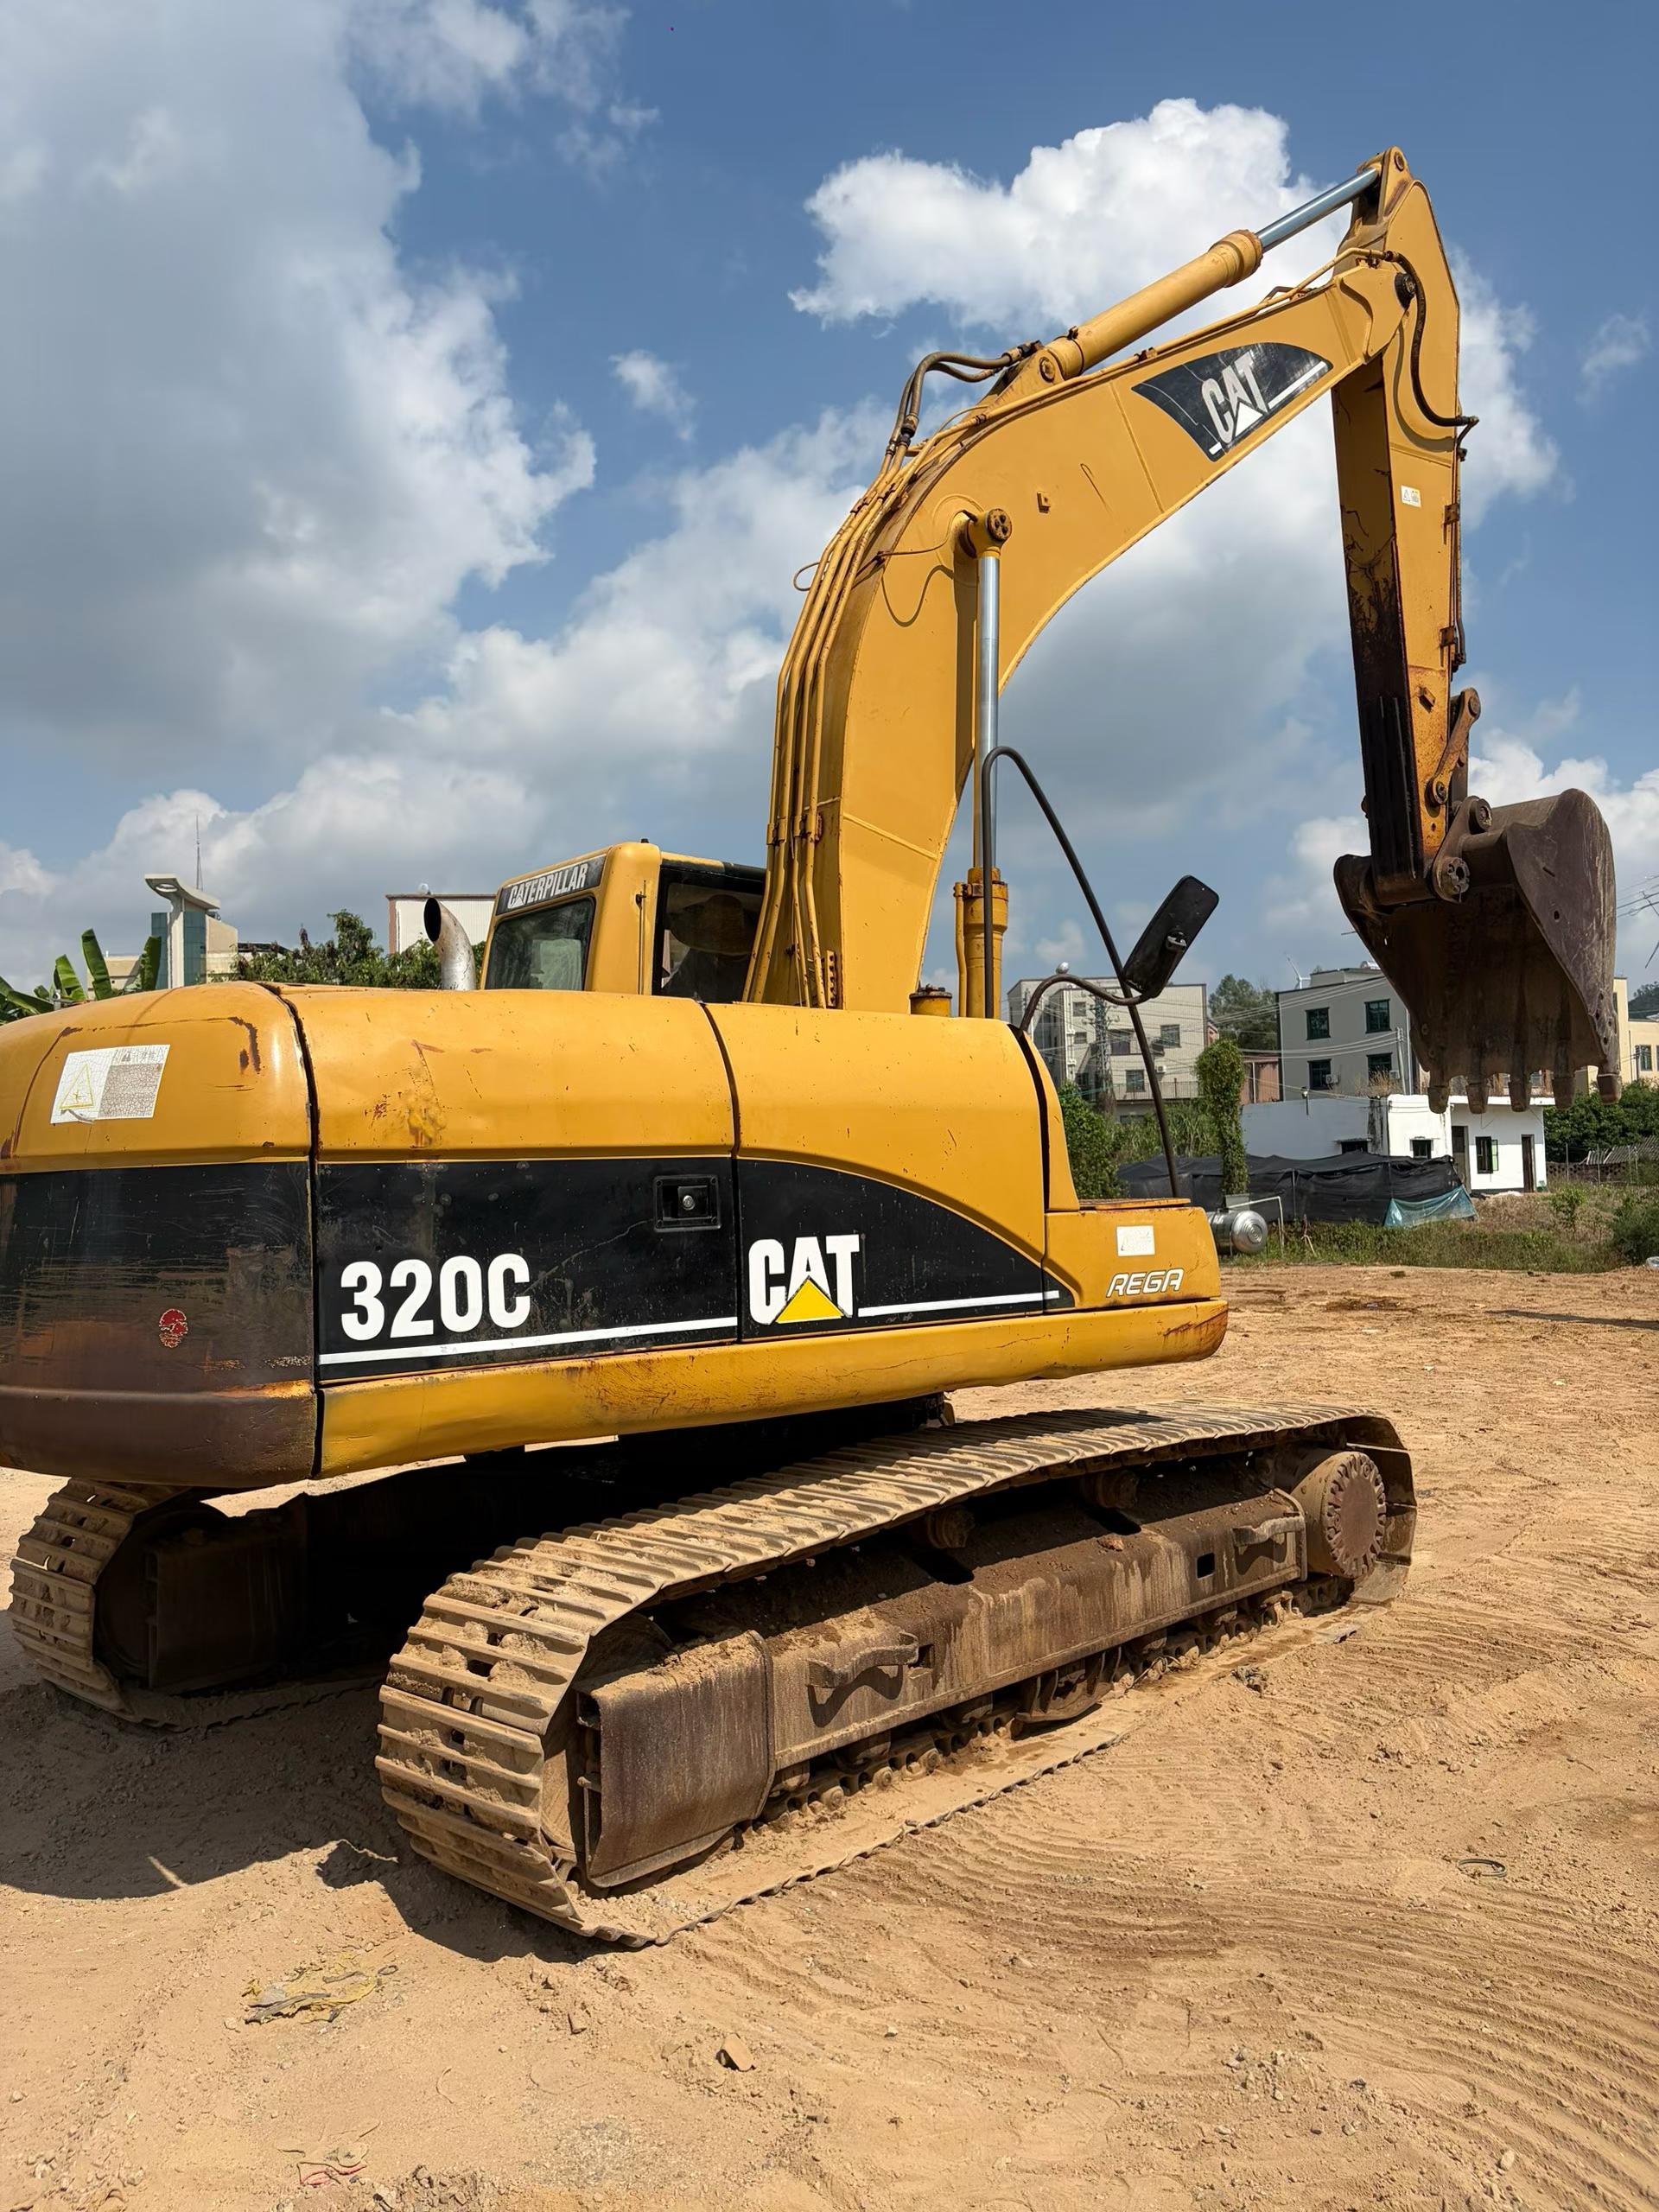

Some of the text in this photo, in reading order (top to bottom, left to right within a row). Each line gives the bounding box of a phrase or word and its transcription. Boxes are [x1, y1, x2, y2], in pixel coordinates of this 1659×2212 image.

[1201, 349, 1268, 444] CAT
[506, 862, 588, 910] CATERPILLAR
[340, 1253, 531, 1341] 320C
[748, 1234, 860, 1325] CAT
[1106, 1267, 1185, 1298] REGA
